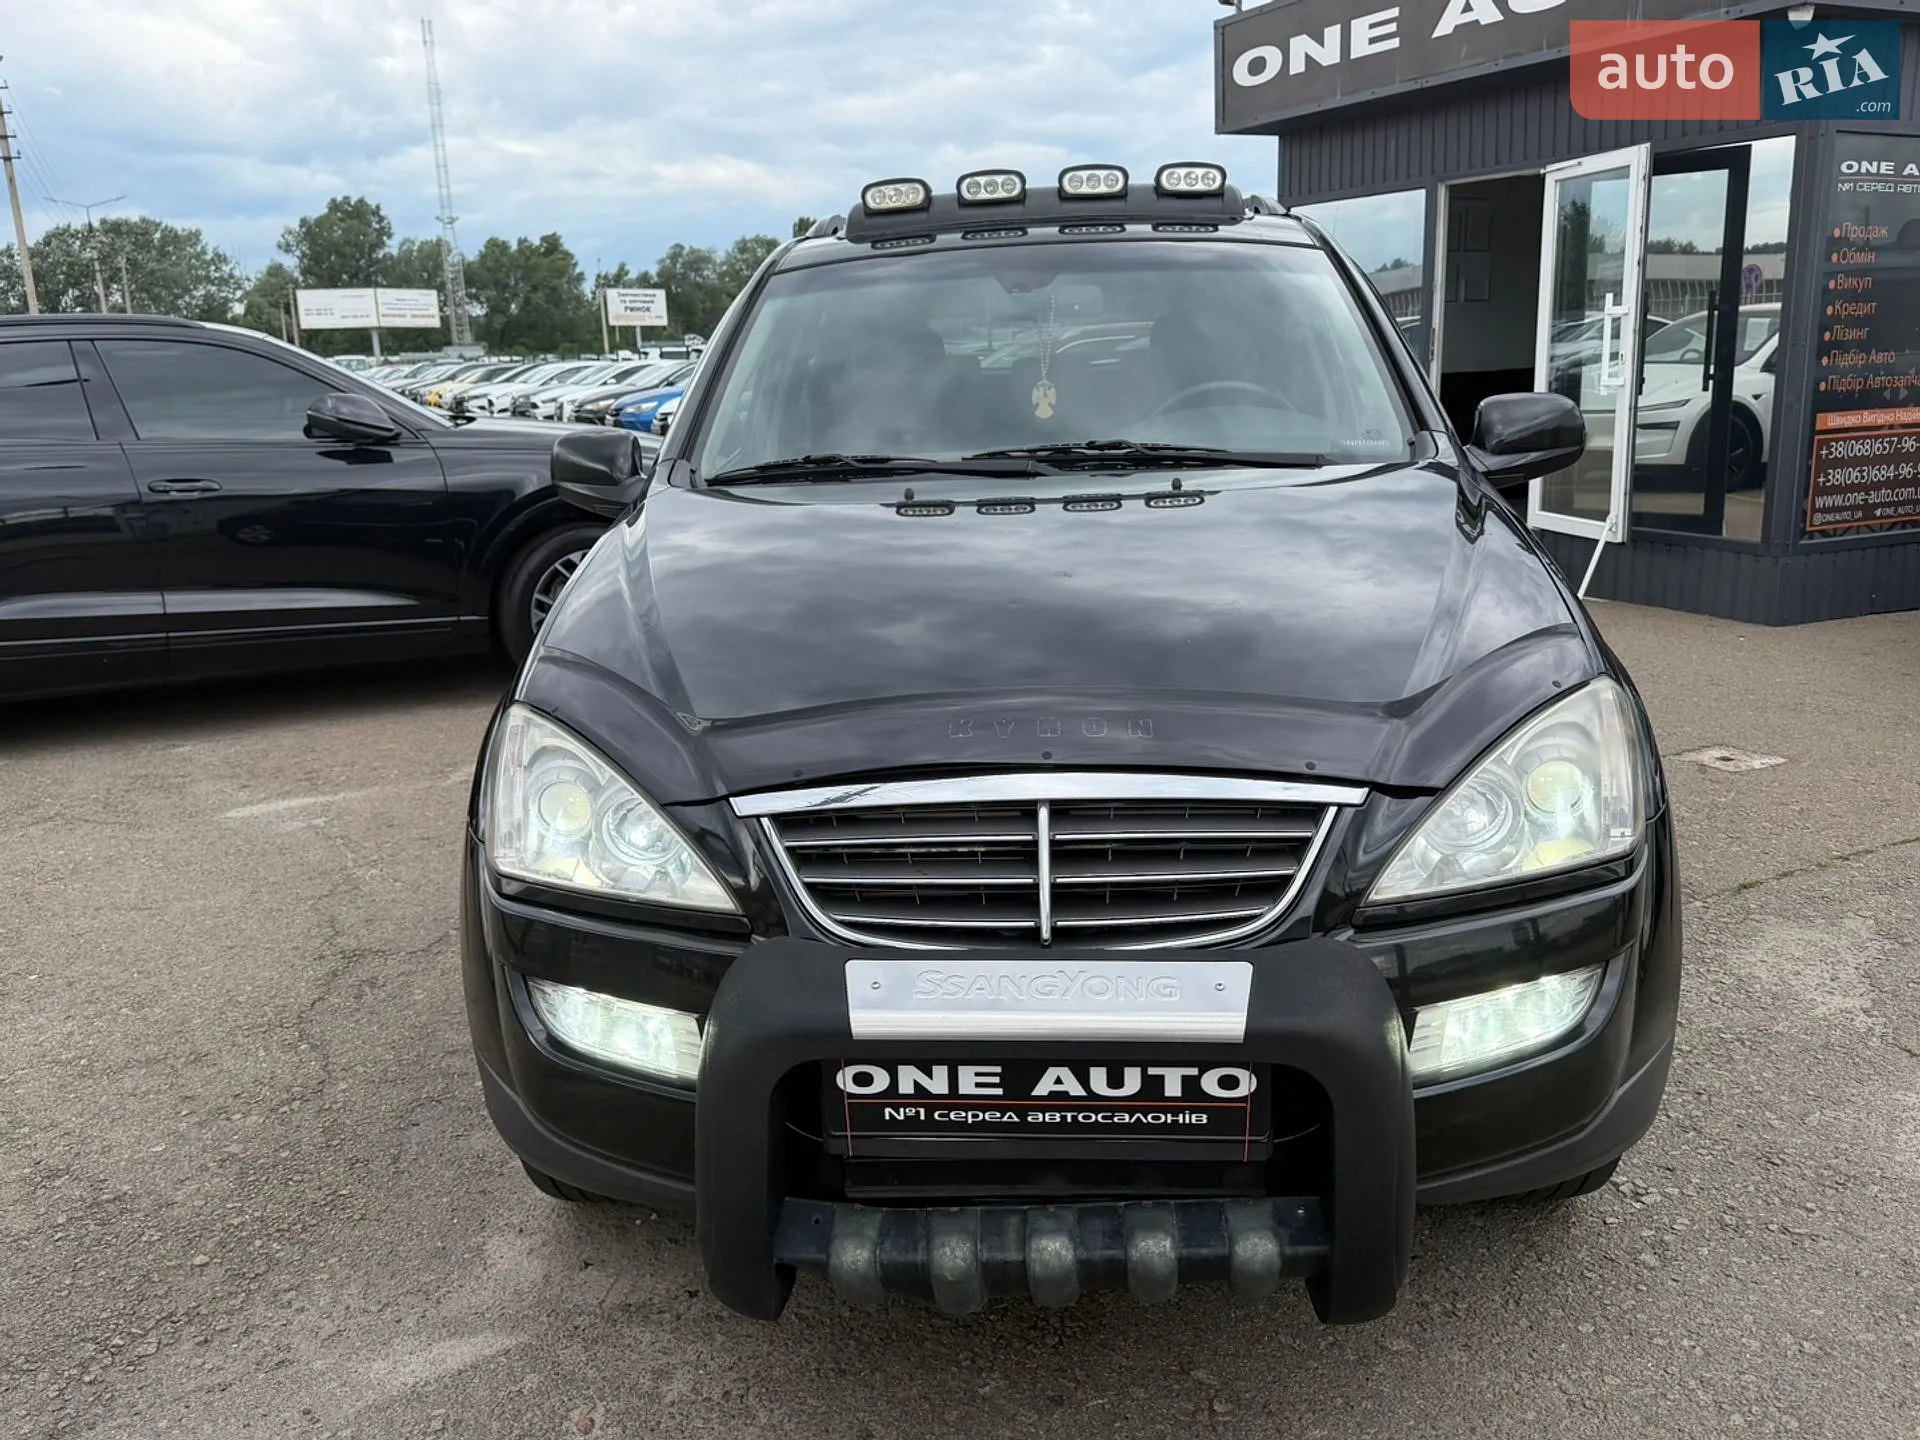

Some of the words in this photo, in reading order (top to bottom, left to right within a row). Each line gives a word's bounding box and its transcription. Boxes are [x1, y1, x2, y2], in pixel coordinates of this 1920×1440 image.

[1232, 6, 1400, 87] ONE
[1839, 160, 1895, 175] ONE
[1856, 182, 1895, 193] СЕРЕД
[1841, 222, 1888, 241] Продаж
[1840, 247, 1876, 264] Обмін
[1837, 273, 1873, 293] Викуп
[1834, 299, 1877, 319] Кредит
[1831, 325, 1870, 341] Лізинг
[1829, 349, 1866, 368] Підбір
[1868, 349, 1896, 364] Авто
[1826, 373, 1863, 393] Підбір
[948, 716, 1154, 738] KYRON
[835, 1063, 1004, 1096] ONE
[1030, 1065, 1258, 1099] AUTO
[933, 1109, 1021, 1124] серед
[1026, 1110, 1208, 1124] автосалонів
